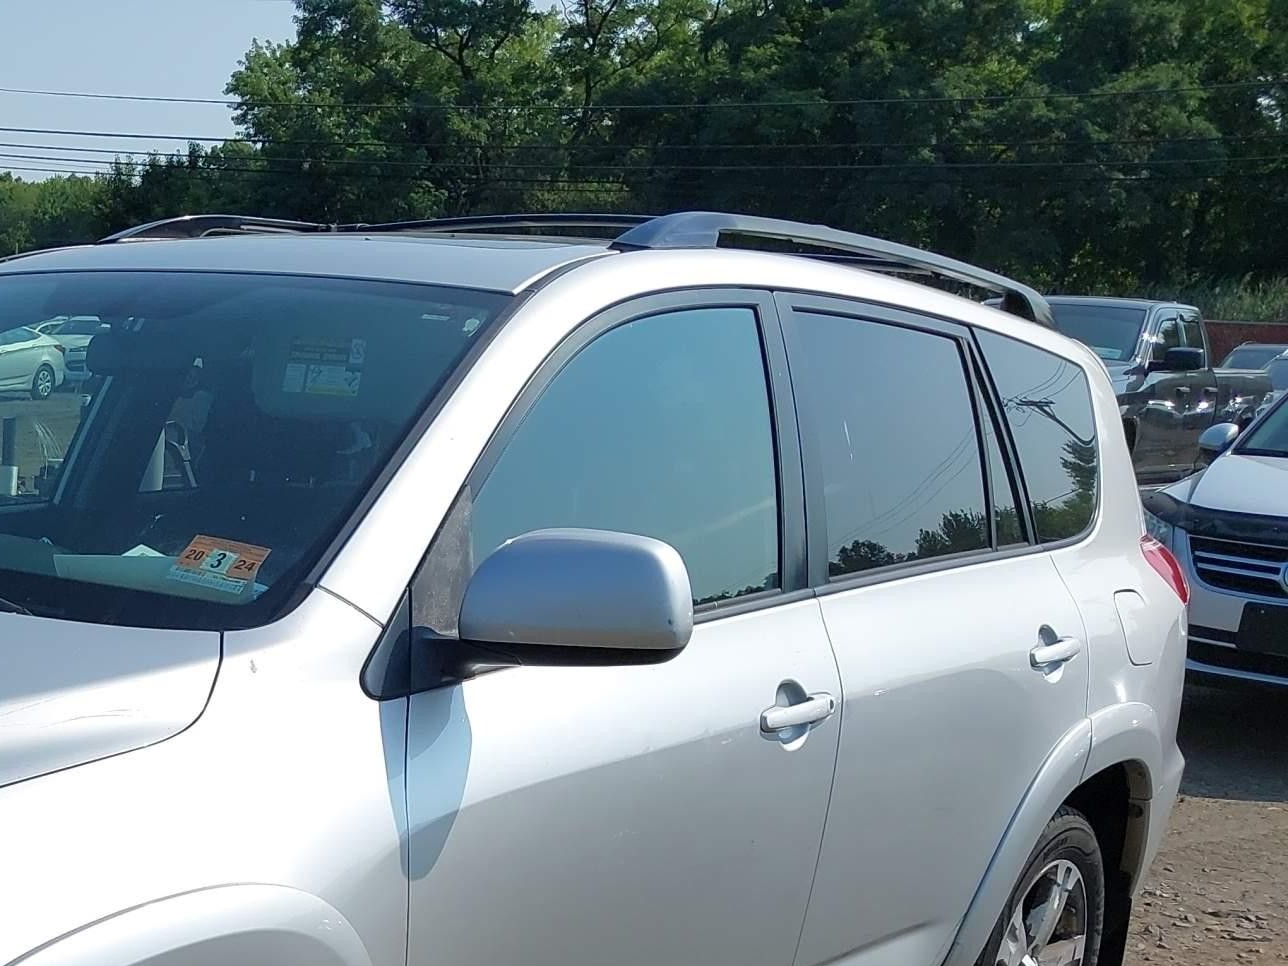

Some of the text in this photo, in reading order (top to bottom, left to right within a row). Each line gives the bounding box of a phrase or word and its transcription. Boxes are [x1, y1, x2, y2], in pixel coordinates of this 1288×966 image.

[185, 549, 257, 572] 20 3 24
